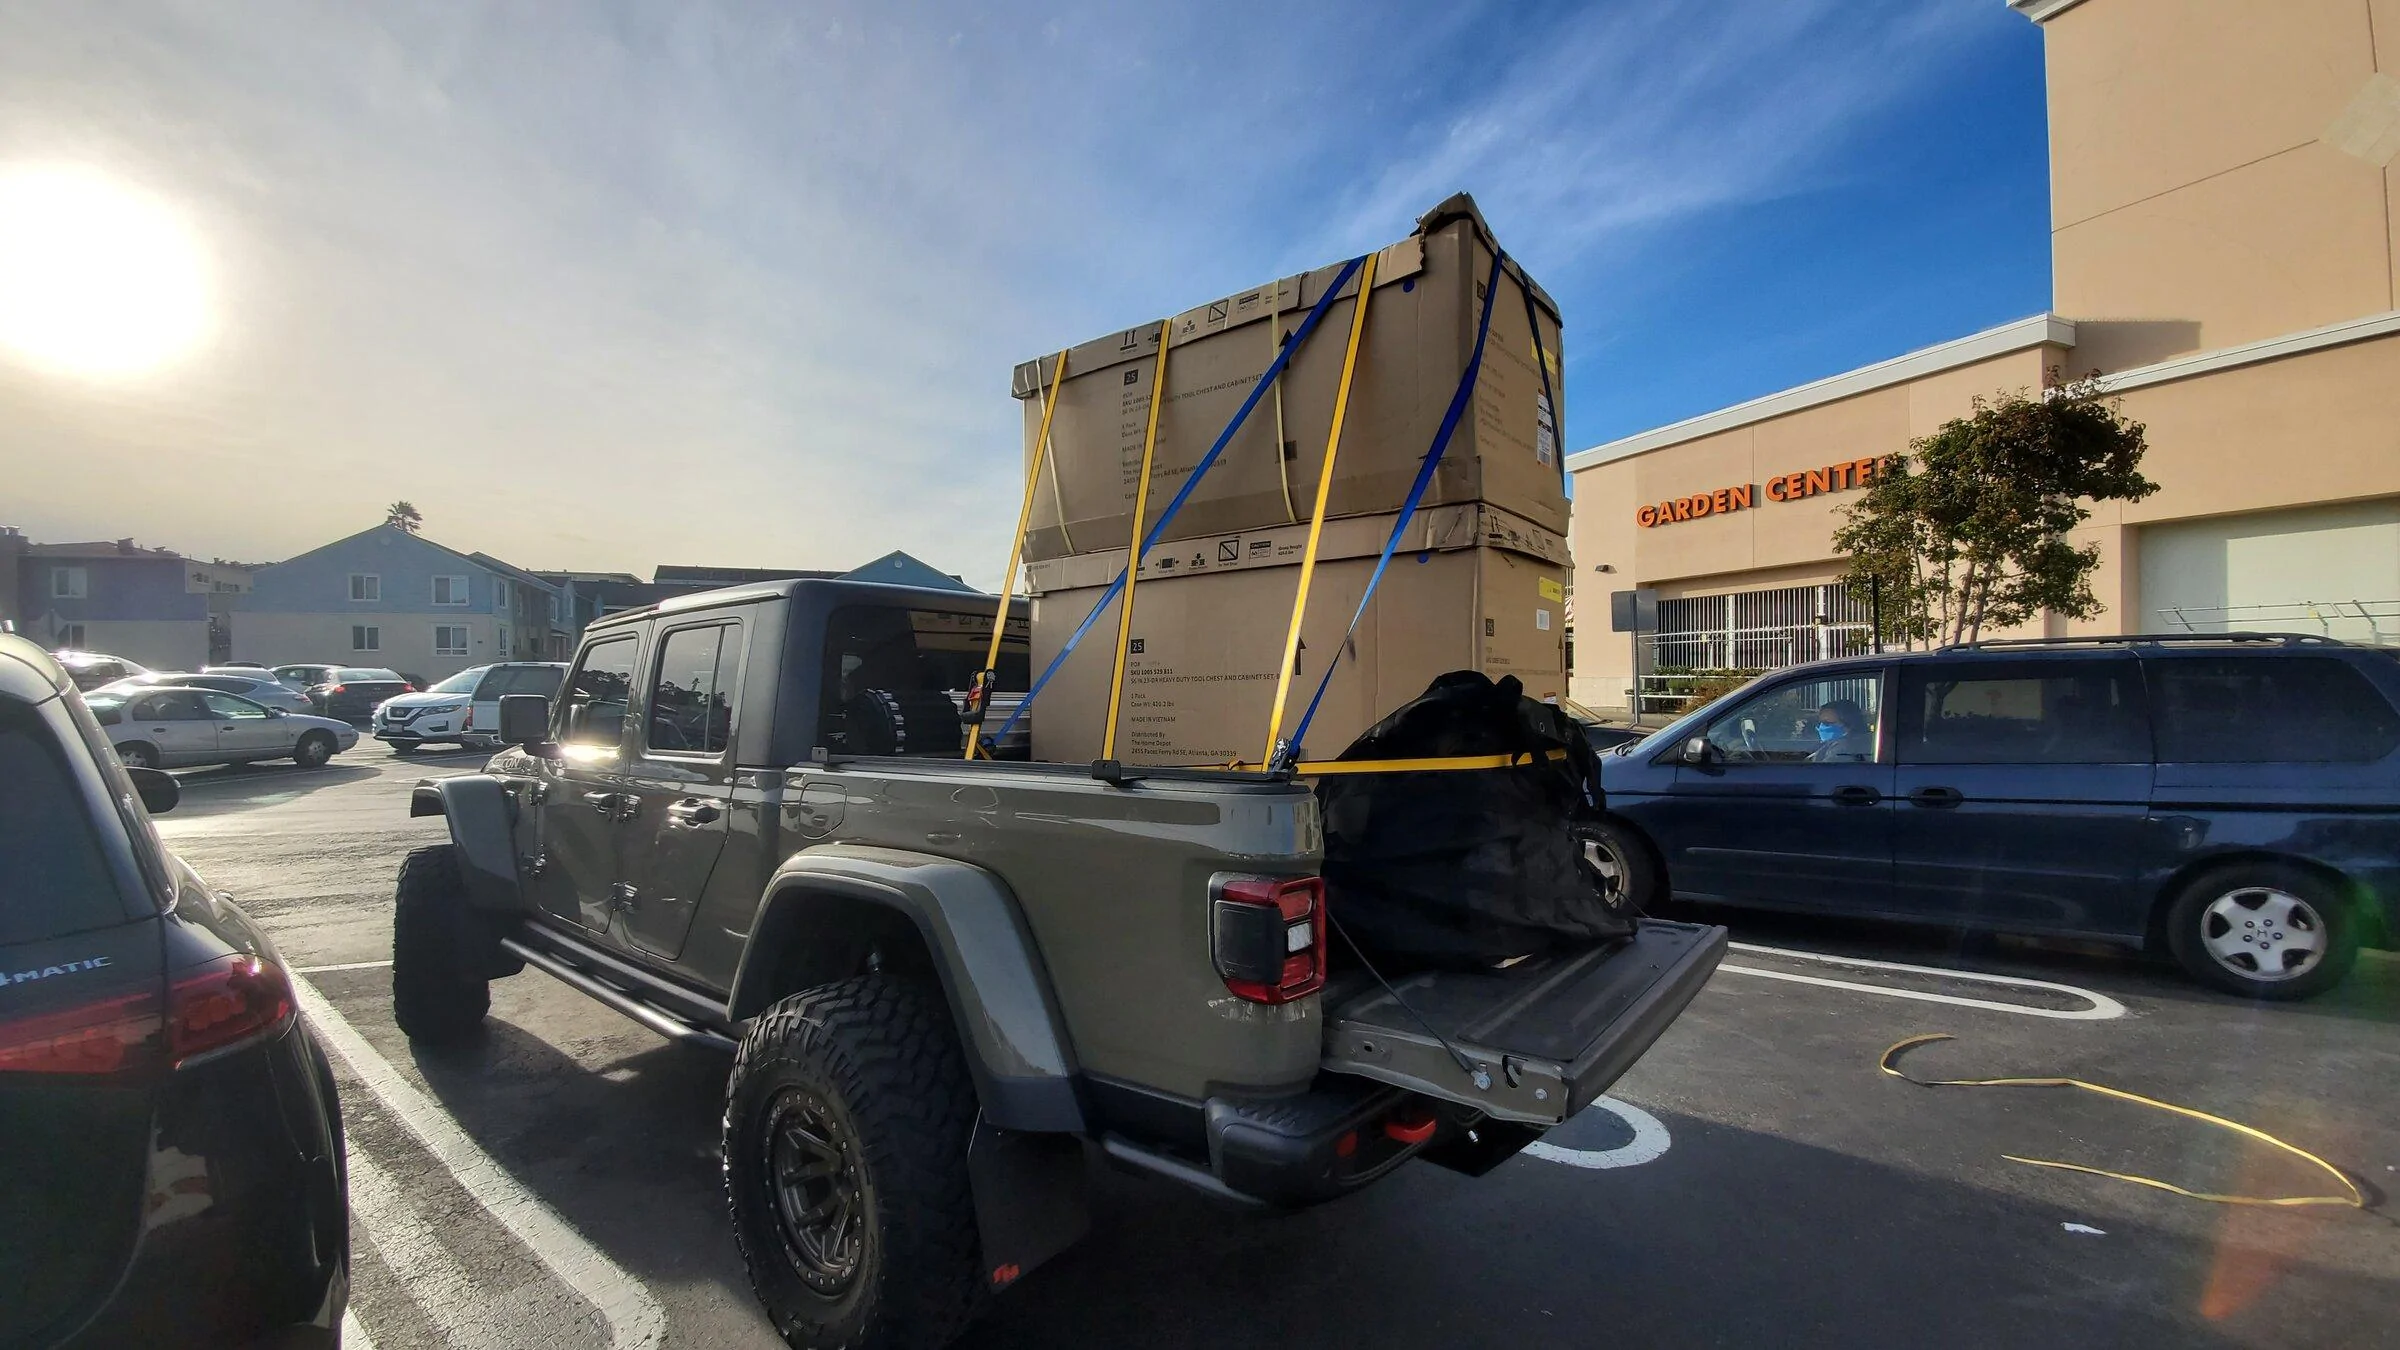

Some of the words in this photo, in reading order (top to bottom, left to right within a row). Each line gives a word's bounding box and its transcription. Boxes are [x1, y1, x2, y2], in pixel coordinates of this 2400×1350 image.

[1196, 387, 1213, 395] CHEST
[1213, 383, 1227, 391] AND
[1227, 377, 1251, 388] CABINET
[1636, 483, 1753, 528] GARDEN
[1132, 642, 1143, 651] 25
[1211, 749, 1219, 757] GA
